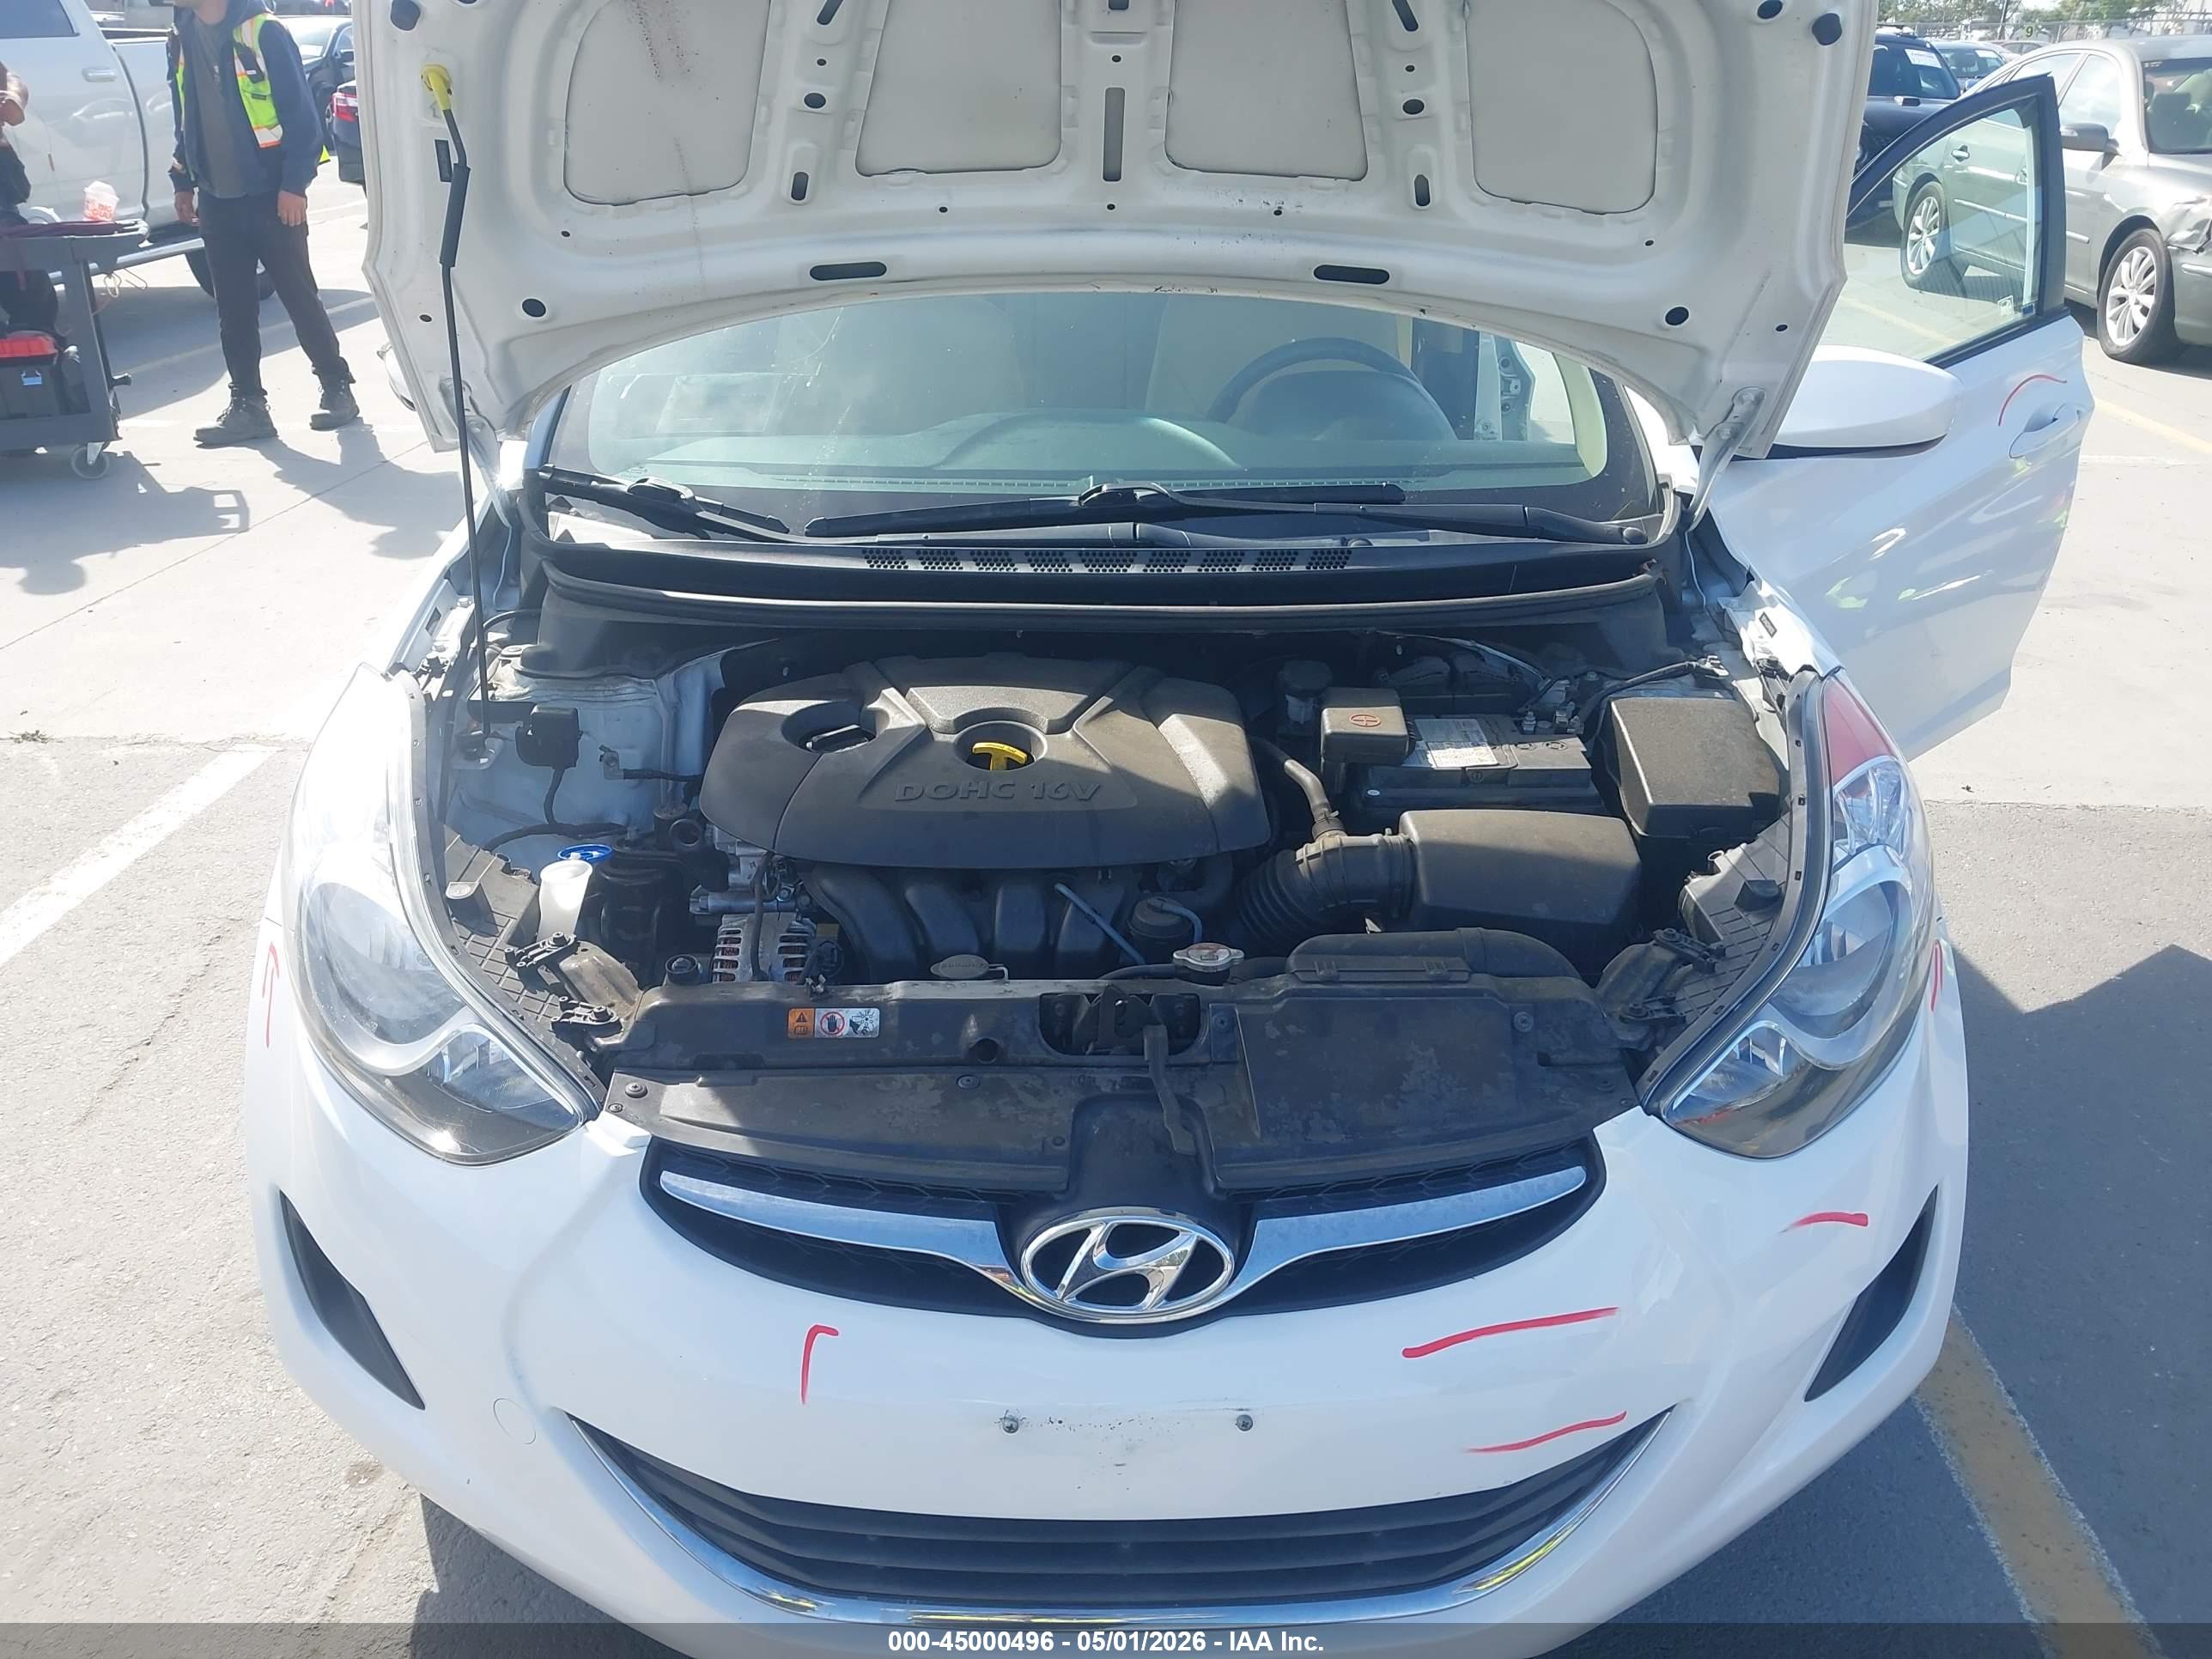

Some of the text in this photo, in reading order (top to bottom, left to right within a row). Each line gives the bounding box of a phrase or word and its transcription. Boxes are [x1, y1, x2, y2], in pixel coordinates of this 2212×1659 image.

[2026, 26, 2033, 38] 9
[894, 778, 1102, 801] DOHC 16V
